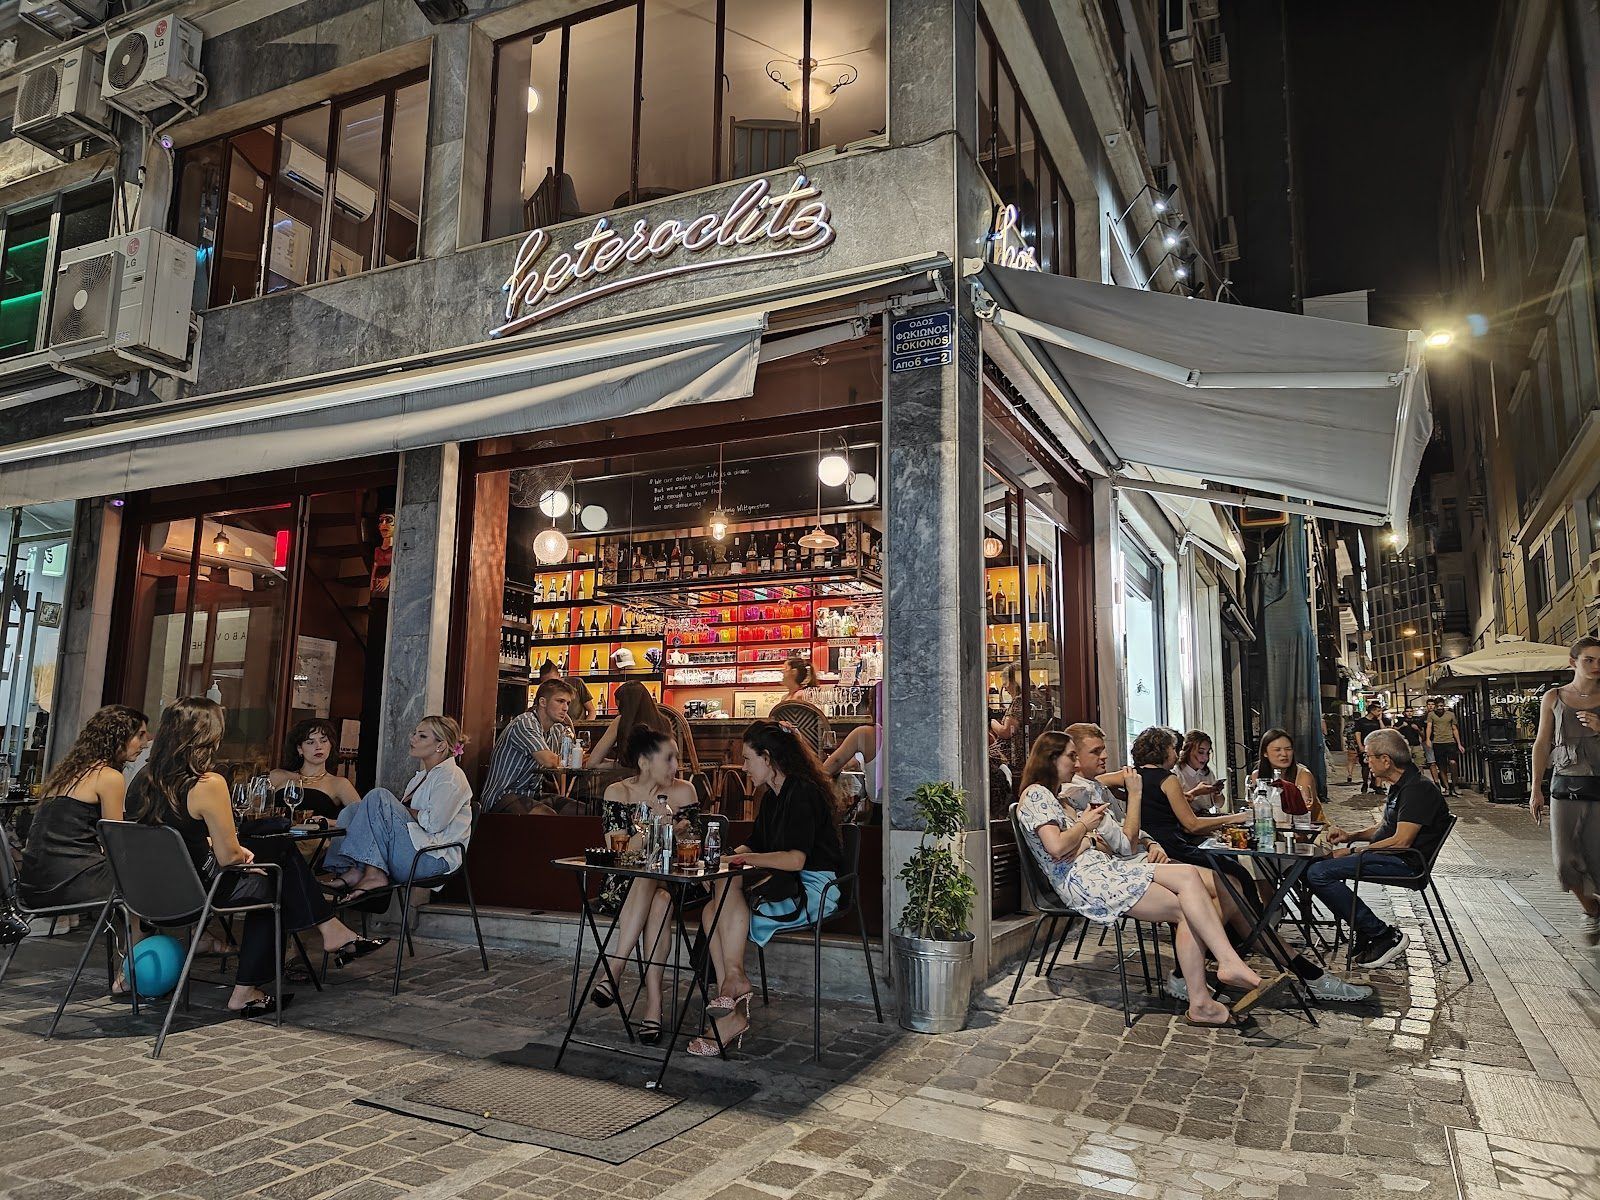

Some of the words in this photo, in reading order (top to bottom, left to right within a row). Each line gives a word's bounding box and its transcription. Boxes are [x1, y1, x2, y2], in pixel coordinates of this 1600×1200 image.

[153, 38, 165, 48] LG
[498, 176, 834, 321] heteroclito
[125, 258, 137, 268] LG
[909, 317, 935, 328] ΟΔΟΣ
[895, 325, 949, 341] ΦΩΚΙΩΝΟΣ
[896, 336, 949, 352] FOKIONOS
[940, 352, 948, 362] 2
